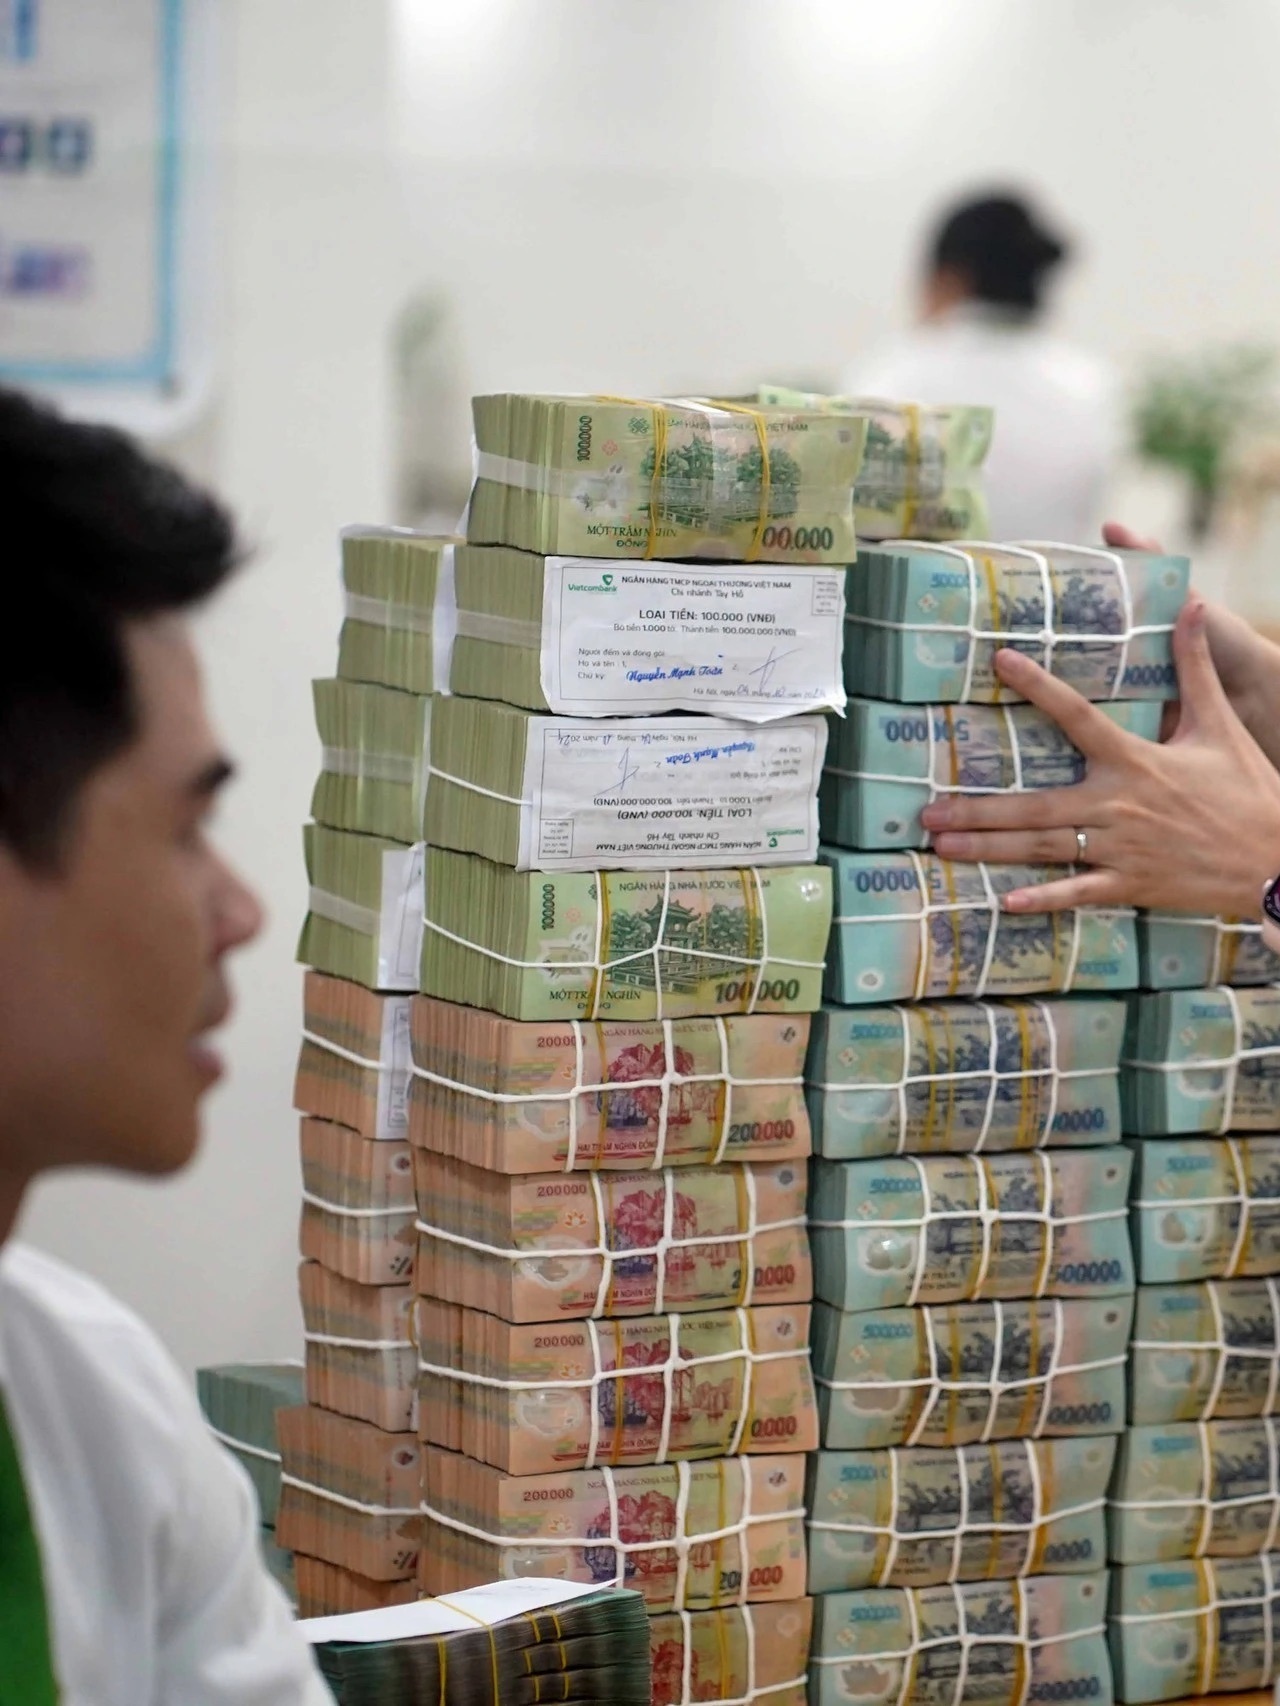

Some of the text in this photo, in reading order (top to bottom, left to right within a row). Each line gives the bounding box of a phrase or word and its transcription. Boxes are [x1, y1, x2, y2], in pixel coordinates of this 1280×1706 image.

[752, 525, 834, 551] 00.000
[621, 575, 645, 585] NGÂN
[670, 578, 691, 586] TMCP
[568, 583, 617, 593] Vietcombank
[701, 612, 743, 622] 100.000
[642, 624, 666, 632] 1.000
[722, 627, 773, 636] 100.000.000
[620, 798, 672, 806] 100.000.000
[651, 810, 693, 819] 100.000
[697, 842, 718, 850] TMCP
[619, 880, 648, 891] NGÂN
[537, 1184, 588, 1198] 200000
[534, 1335, 585, 1349] 200000
[523, 1487, 575, 1502] 200000
